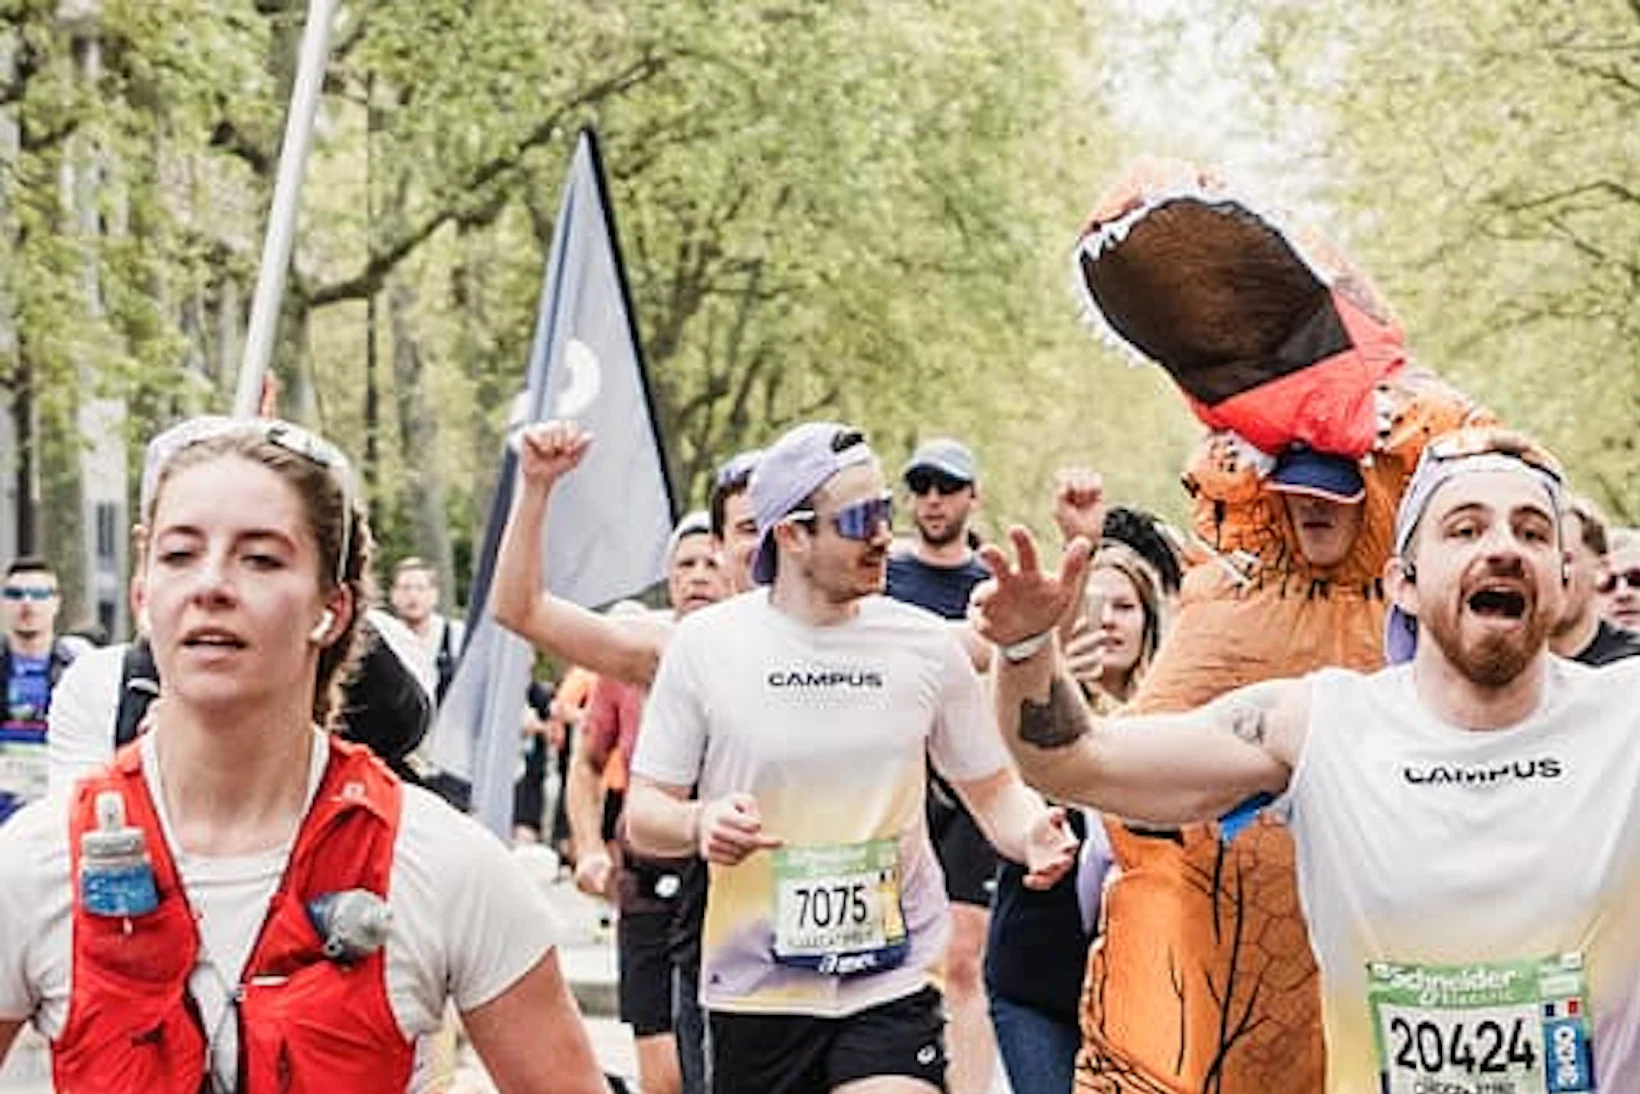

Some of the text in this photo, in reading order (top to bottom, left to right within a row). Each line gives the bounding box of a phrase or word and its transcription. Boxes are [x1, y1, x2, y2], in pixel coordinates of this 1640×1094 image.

[767, 672, 883, 687] CAMPUS
[795, 884, 868, 928] 7075
[1390, 1015, 1536, 1073] 20424
